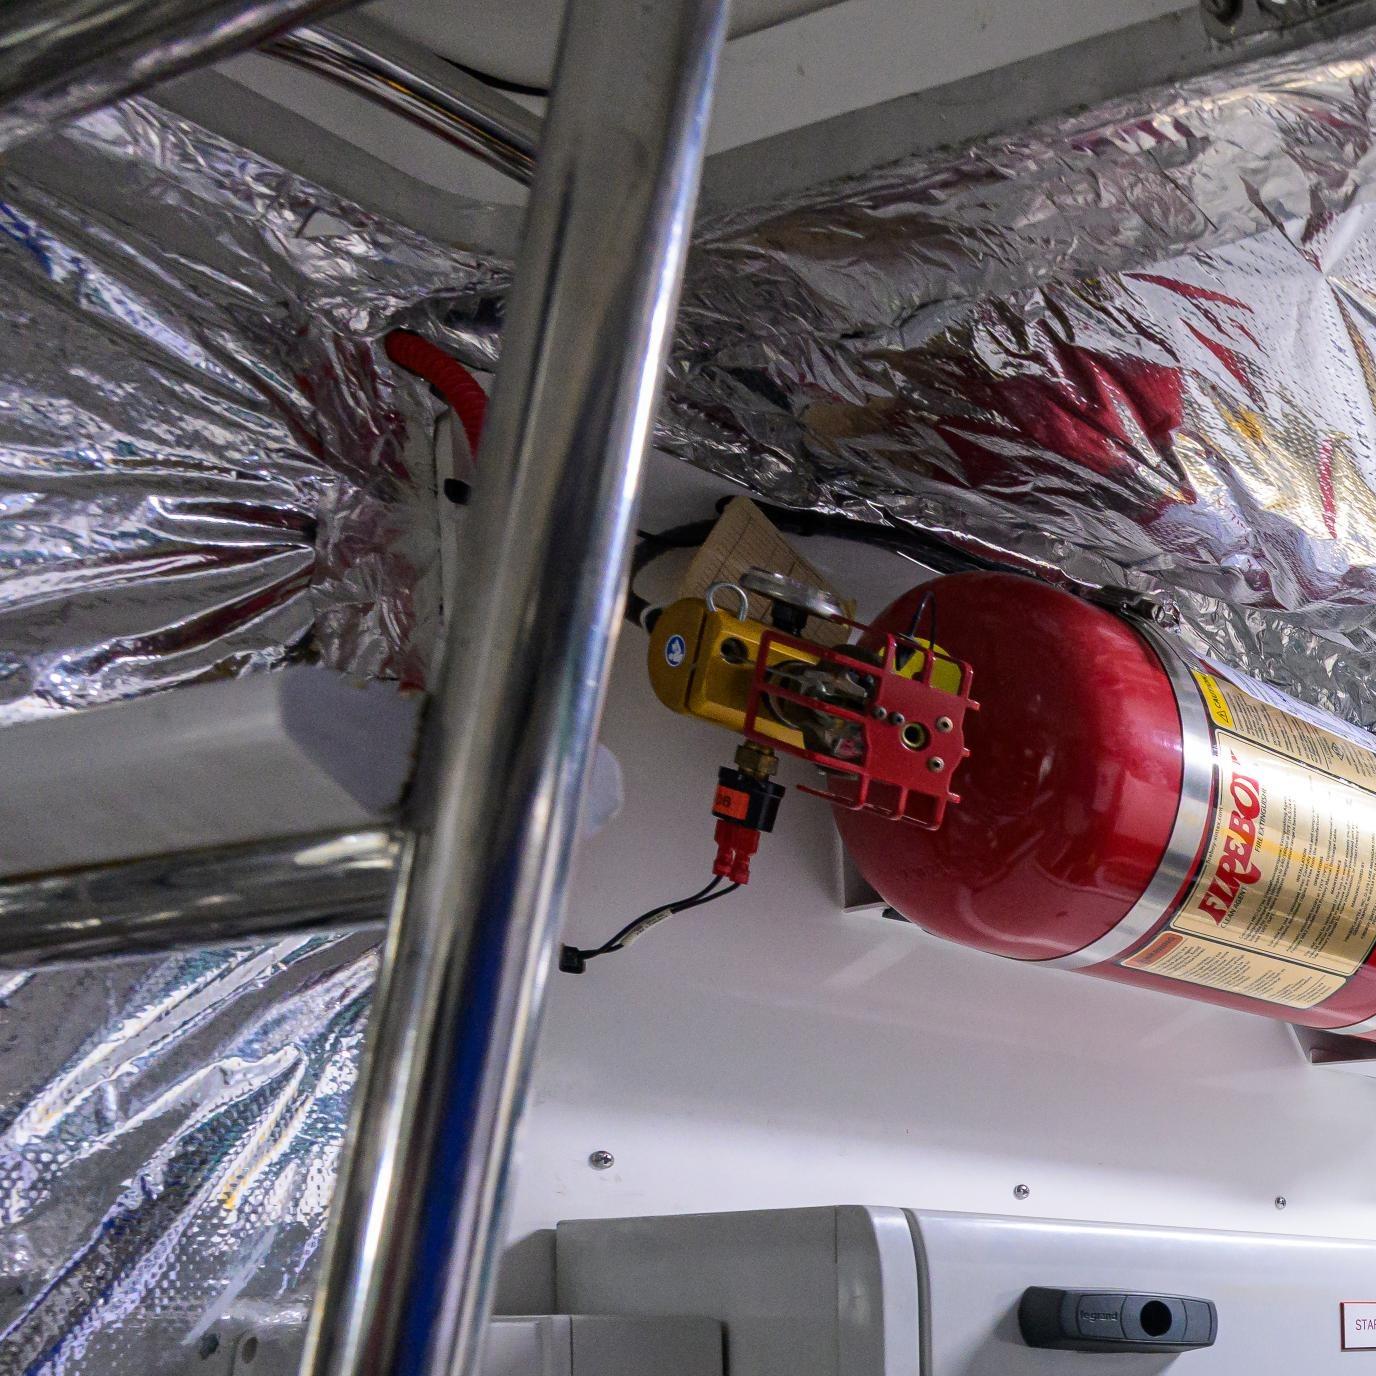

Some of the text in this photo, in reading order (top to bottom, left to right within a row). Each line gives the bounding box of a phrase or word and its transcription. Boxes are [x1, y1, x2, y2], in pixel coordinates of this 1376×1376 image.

[1231, 886, 1248, 908] AGENT
[1254, 833, 1264, 854] FIRE
[1079, 1310, 1119, 1323] legrand
